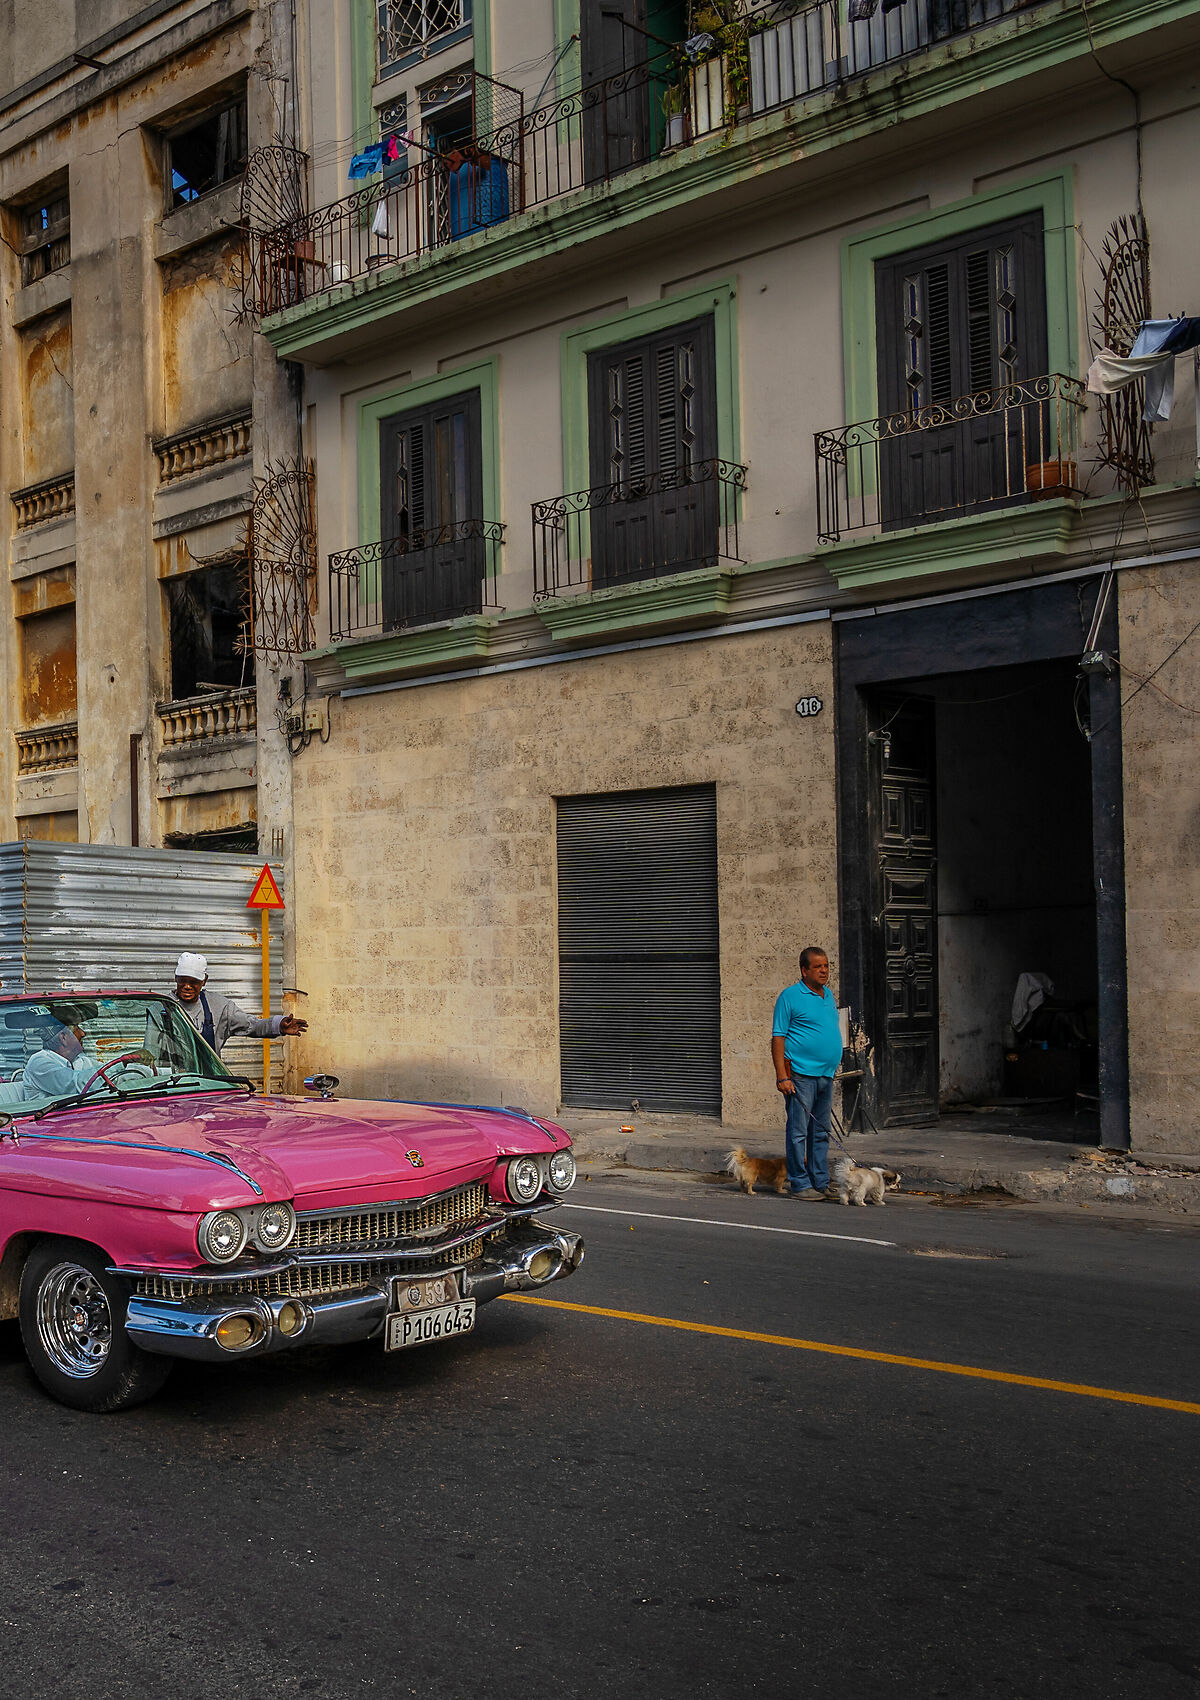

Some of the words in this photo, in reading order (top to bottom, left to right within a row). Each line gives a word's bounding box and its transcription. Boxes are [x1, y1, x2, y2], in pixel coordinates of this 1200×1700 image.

[801, 700, 818, 714] 116
[425, 1280, 446, 1305] 59
[444, 1308, 473, 1334] 643
